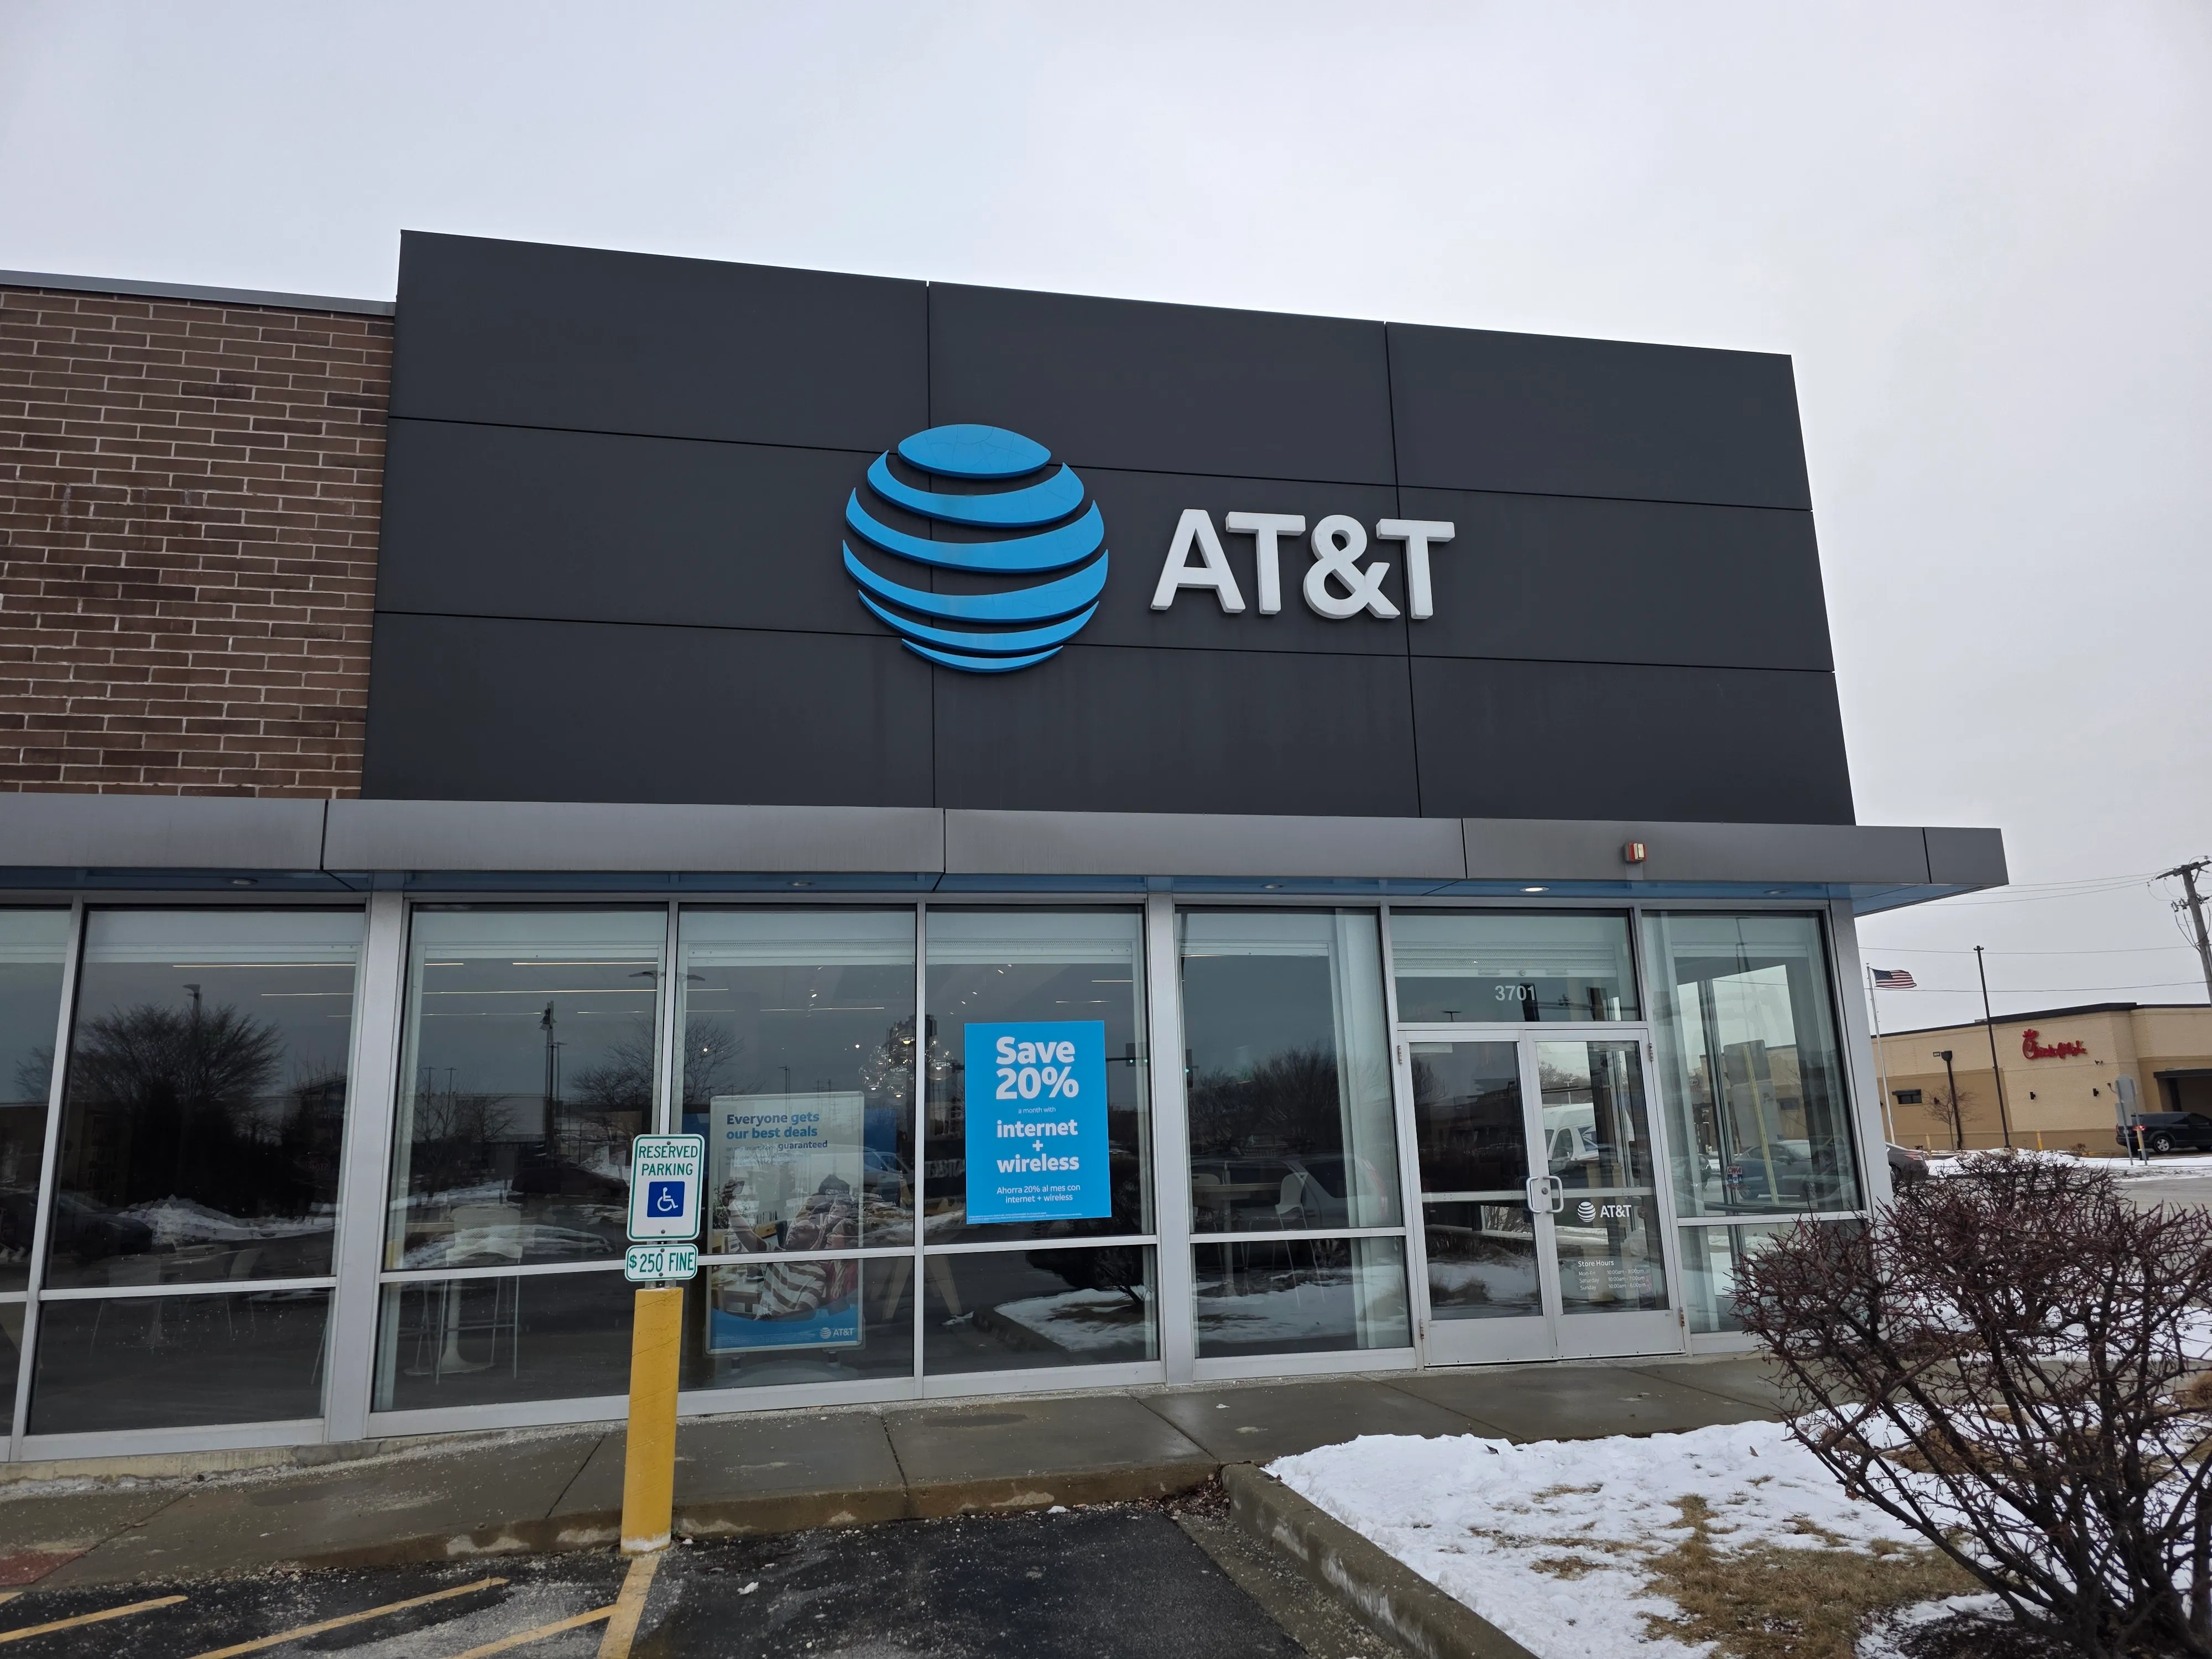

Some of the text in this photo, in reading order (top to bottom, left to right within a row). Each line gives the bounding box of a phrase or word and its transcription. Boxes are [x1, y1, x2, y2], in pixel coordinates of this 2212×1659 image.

[1150, 509, 1455, 619] AT&T
[1495, 985, 1535, 1001] 3701
[996, 1036, 1075, 1065] Save
[996, 1066, 1079, 1100] 20%
[727, 1112, 820, 1126] Everyone gets
[726, 1125, 818, 1139] our best deals
[997, 1119, 1078, 1138] internet
[639, 1145, 698, 1159] RESERVED
[778, 1140, 828, 1151] guaranteed
[1032, 1140, 1044, 1151] +
[641, 1163, 693, 1176] PARKING
[997, 1154, 1079, 1172] wireless
[1005, 1195, 1035, 1203] internet
[1044, 1193, 1073, 1202] wireless
[1600, 1205, 1631, 1218] AT&T
[669, 1252, 694, 1271] FINE
[833, 1328, 854, 1337] AT&T
